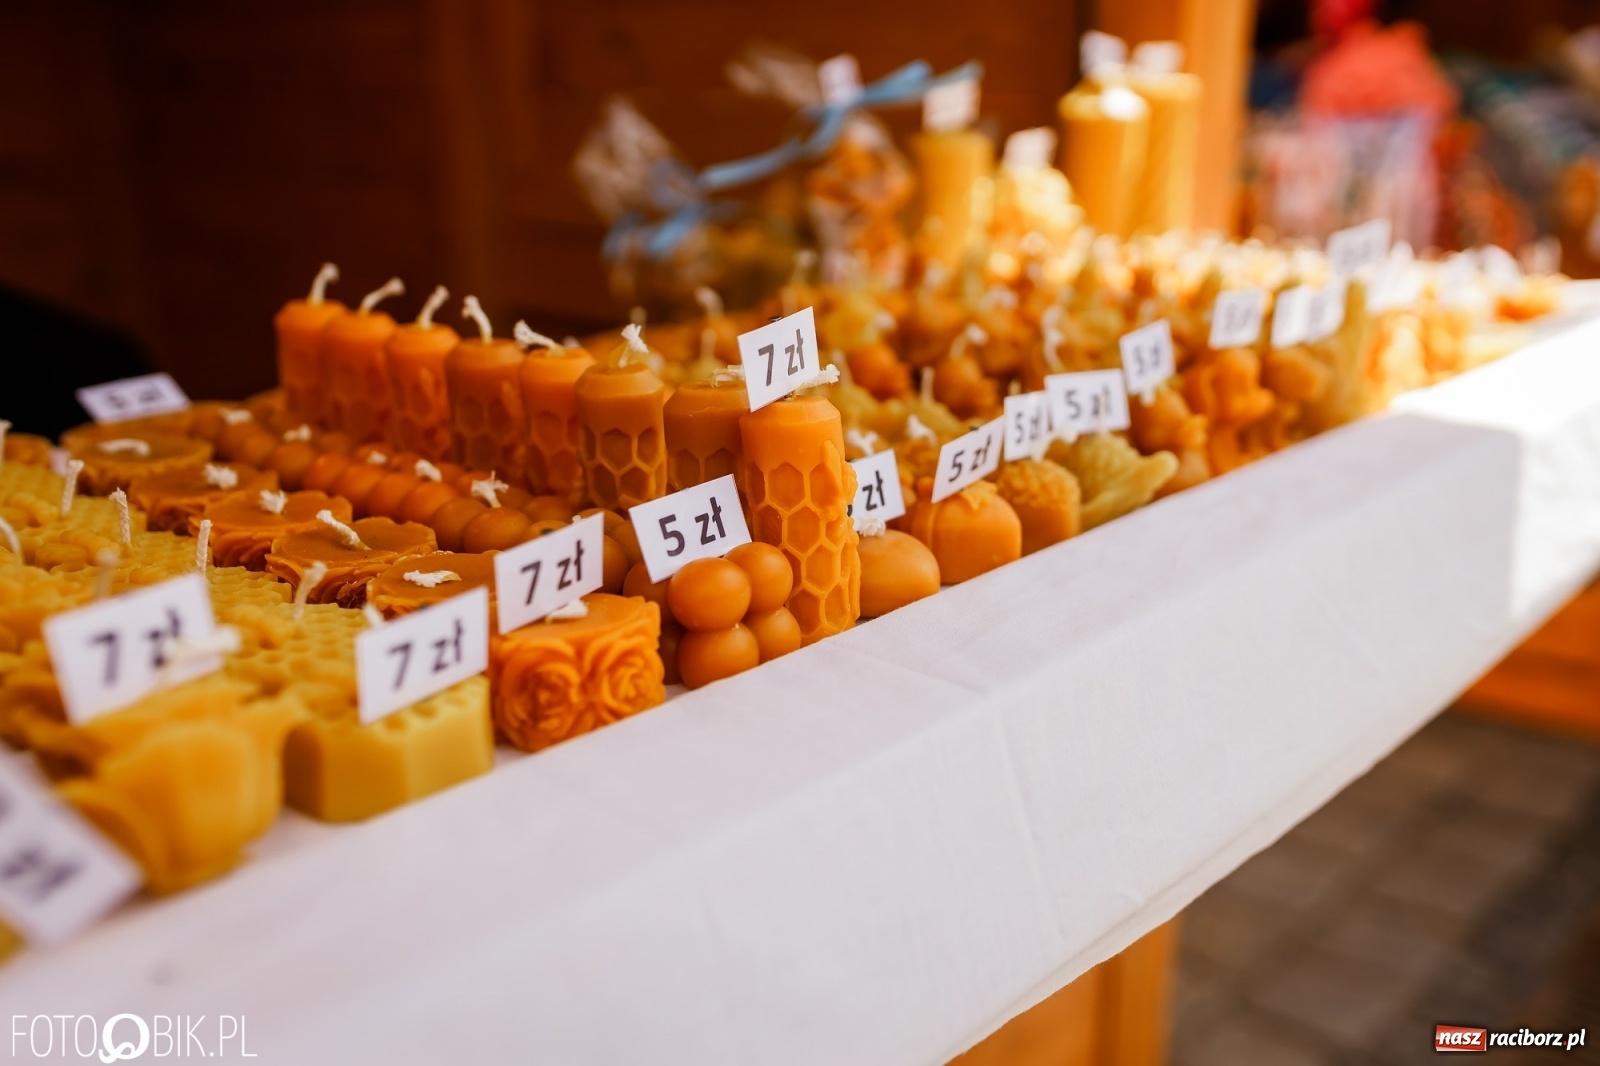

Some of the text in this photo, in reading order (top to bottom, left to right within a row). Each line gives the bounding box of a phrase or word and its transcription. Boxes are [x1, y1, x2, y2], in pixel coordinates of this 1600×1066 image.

[758, 328, 804, 387] 7 zł
[1014, 411, 1024, 445] 5
[1064, 389, 1081, 420] 5
[948, 435, 993, 482] 5 zł
[862, 470, 887, 512] zł
[658, 496, 728, 558] 5 zł
[520, 538, 584, 607] 7 zł
[87, 631, 121, 686] 7
[388, 617, 466, 691] 7 zł
